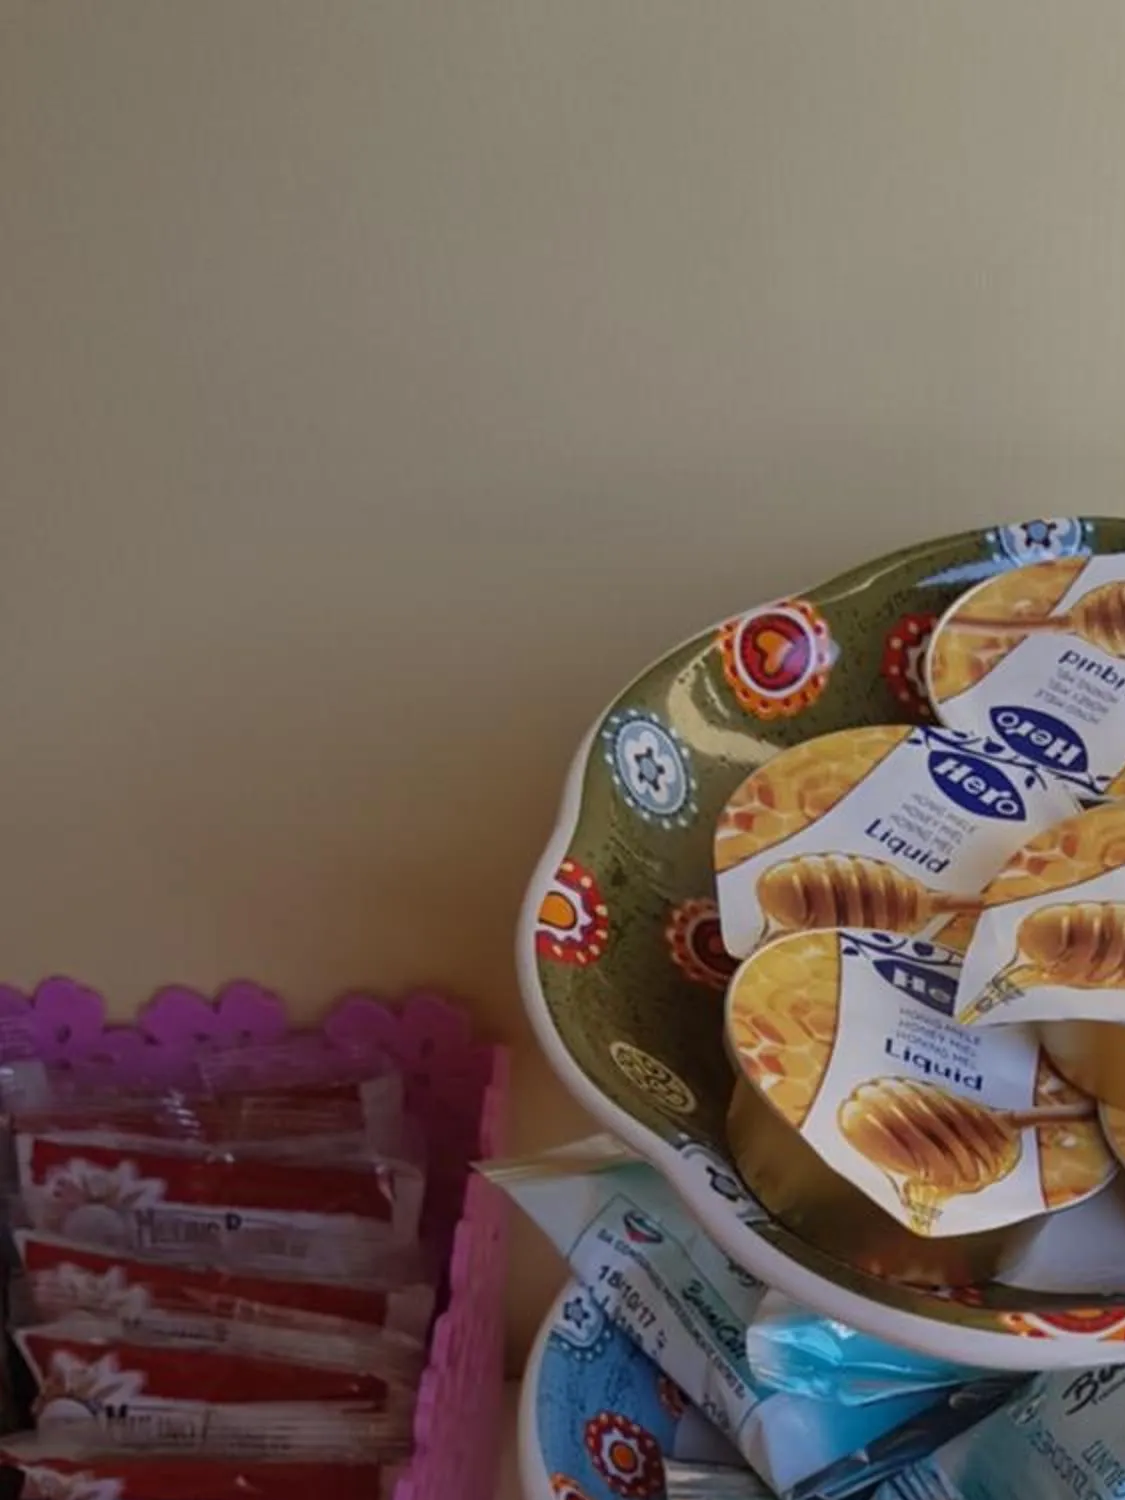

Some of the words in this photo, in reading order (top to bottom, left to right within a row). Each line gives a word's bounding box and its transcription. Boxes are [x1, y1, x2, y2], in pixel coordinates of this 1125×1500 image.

[996, 711, 1083, 766] Hero
[933, 758, 1019, 816] Hero
[864, 818, 950, 874] Liquid
[892, 966, 952, 1004] He
[885, 1038, 984, 1092] Liquid
